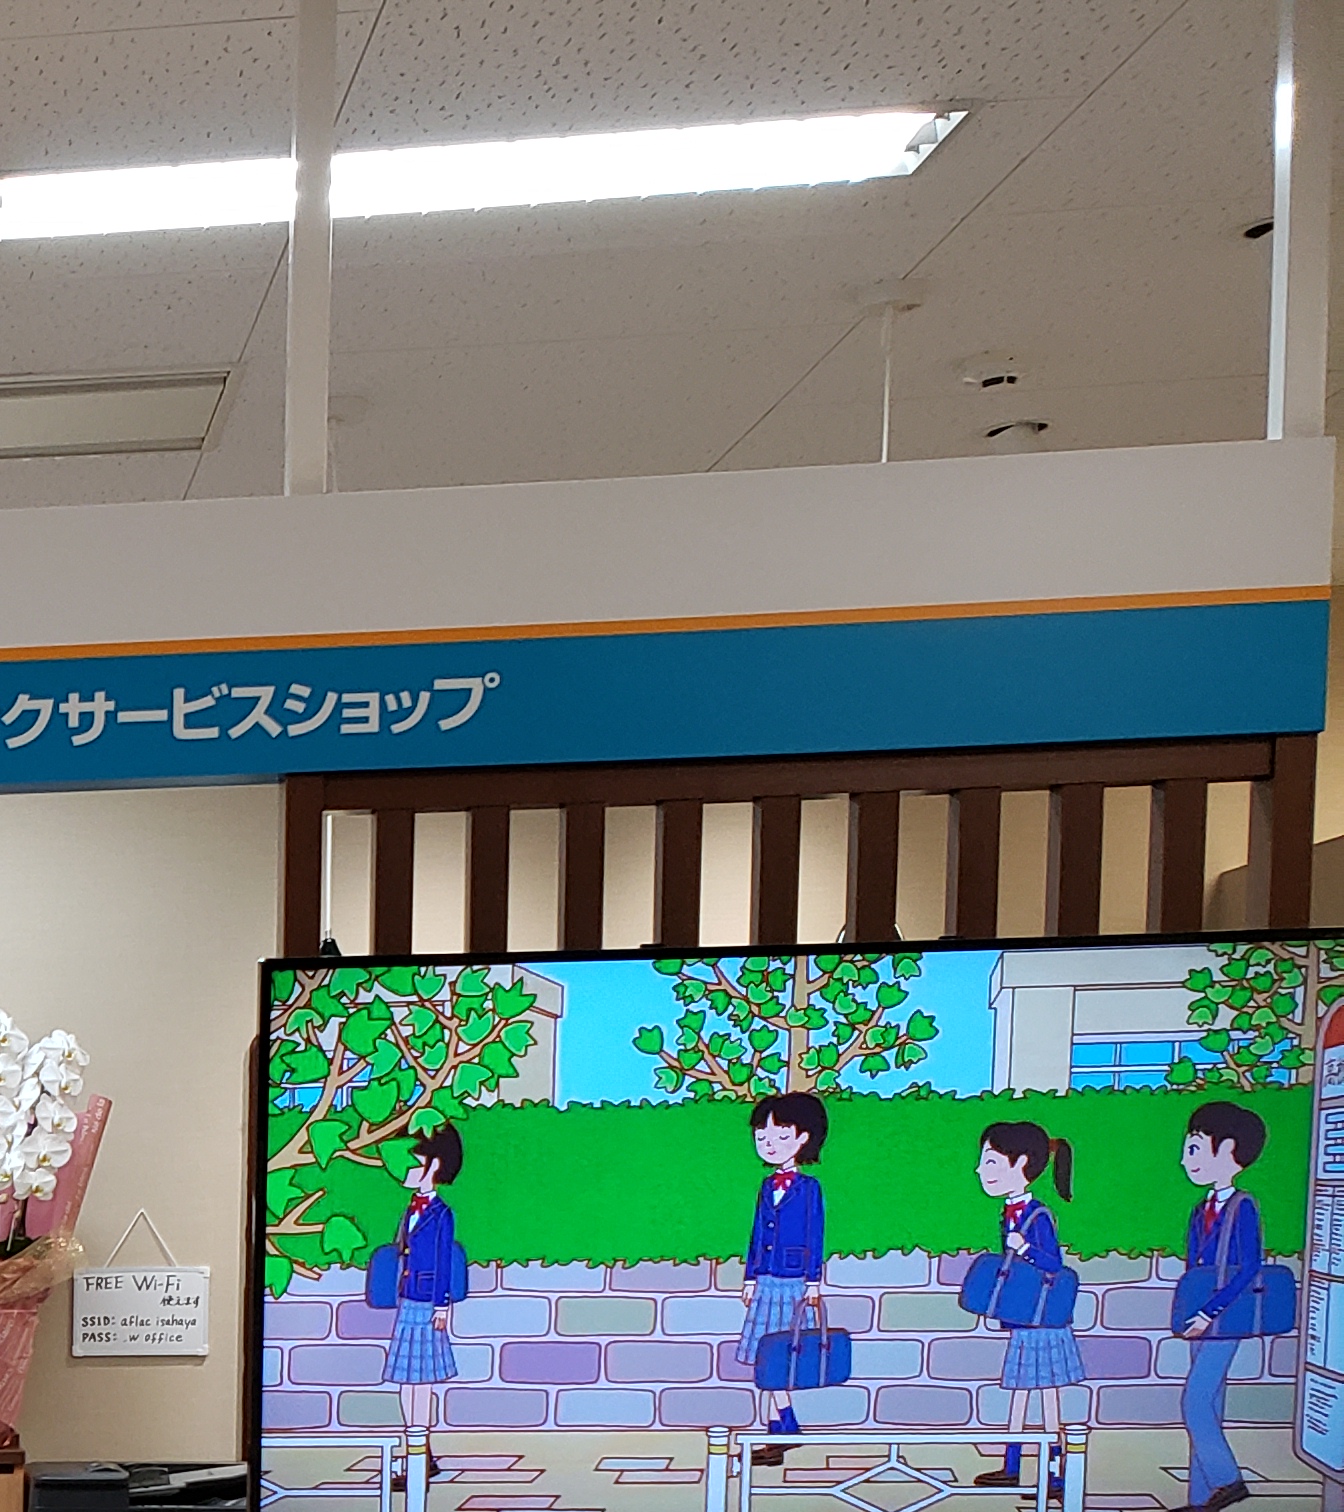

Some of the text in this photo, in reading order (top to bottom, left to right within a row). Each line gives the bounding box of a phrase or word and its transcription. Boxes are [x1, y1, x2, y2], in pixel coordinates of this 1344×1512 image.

[83, 1275, 181, 1293] FREE Wi-Fi
[121, 1316, 151, 1327] aflac
[82, 1332, 117, 1342] PASS:
